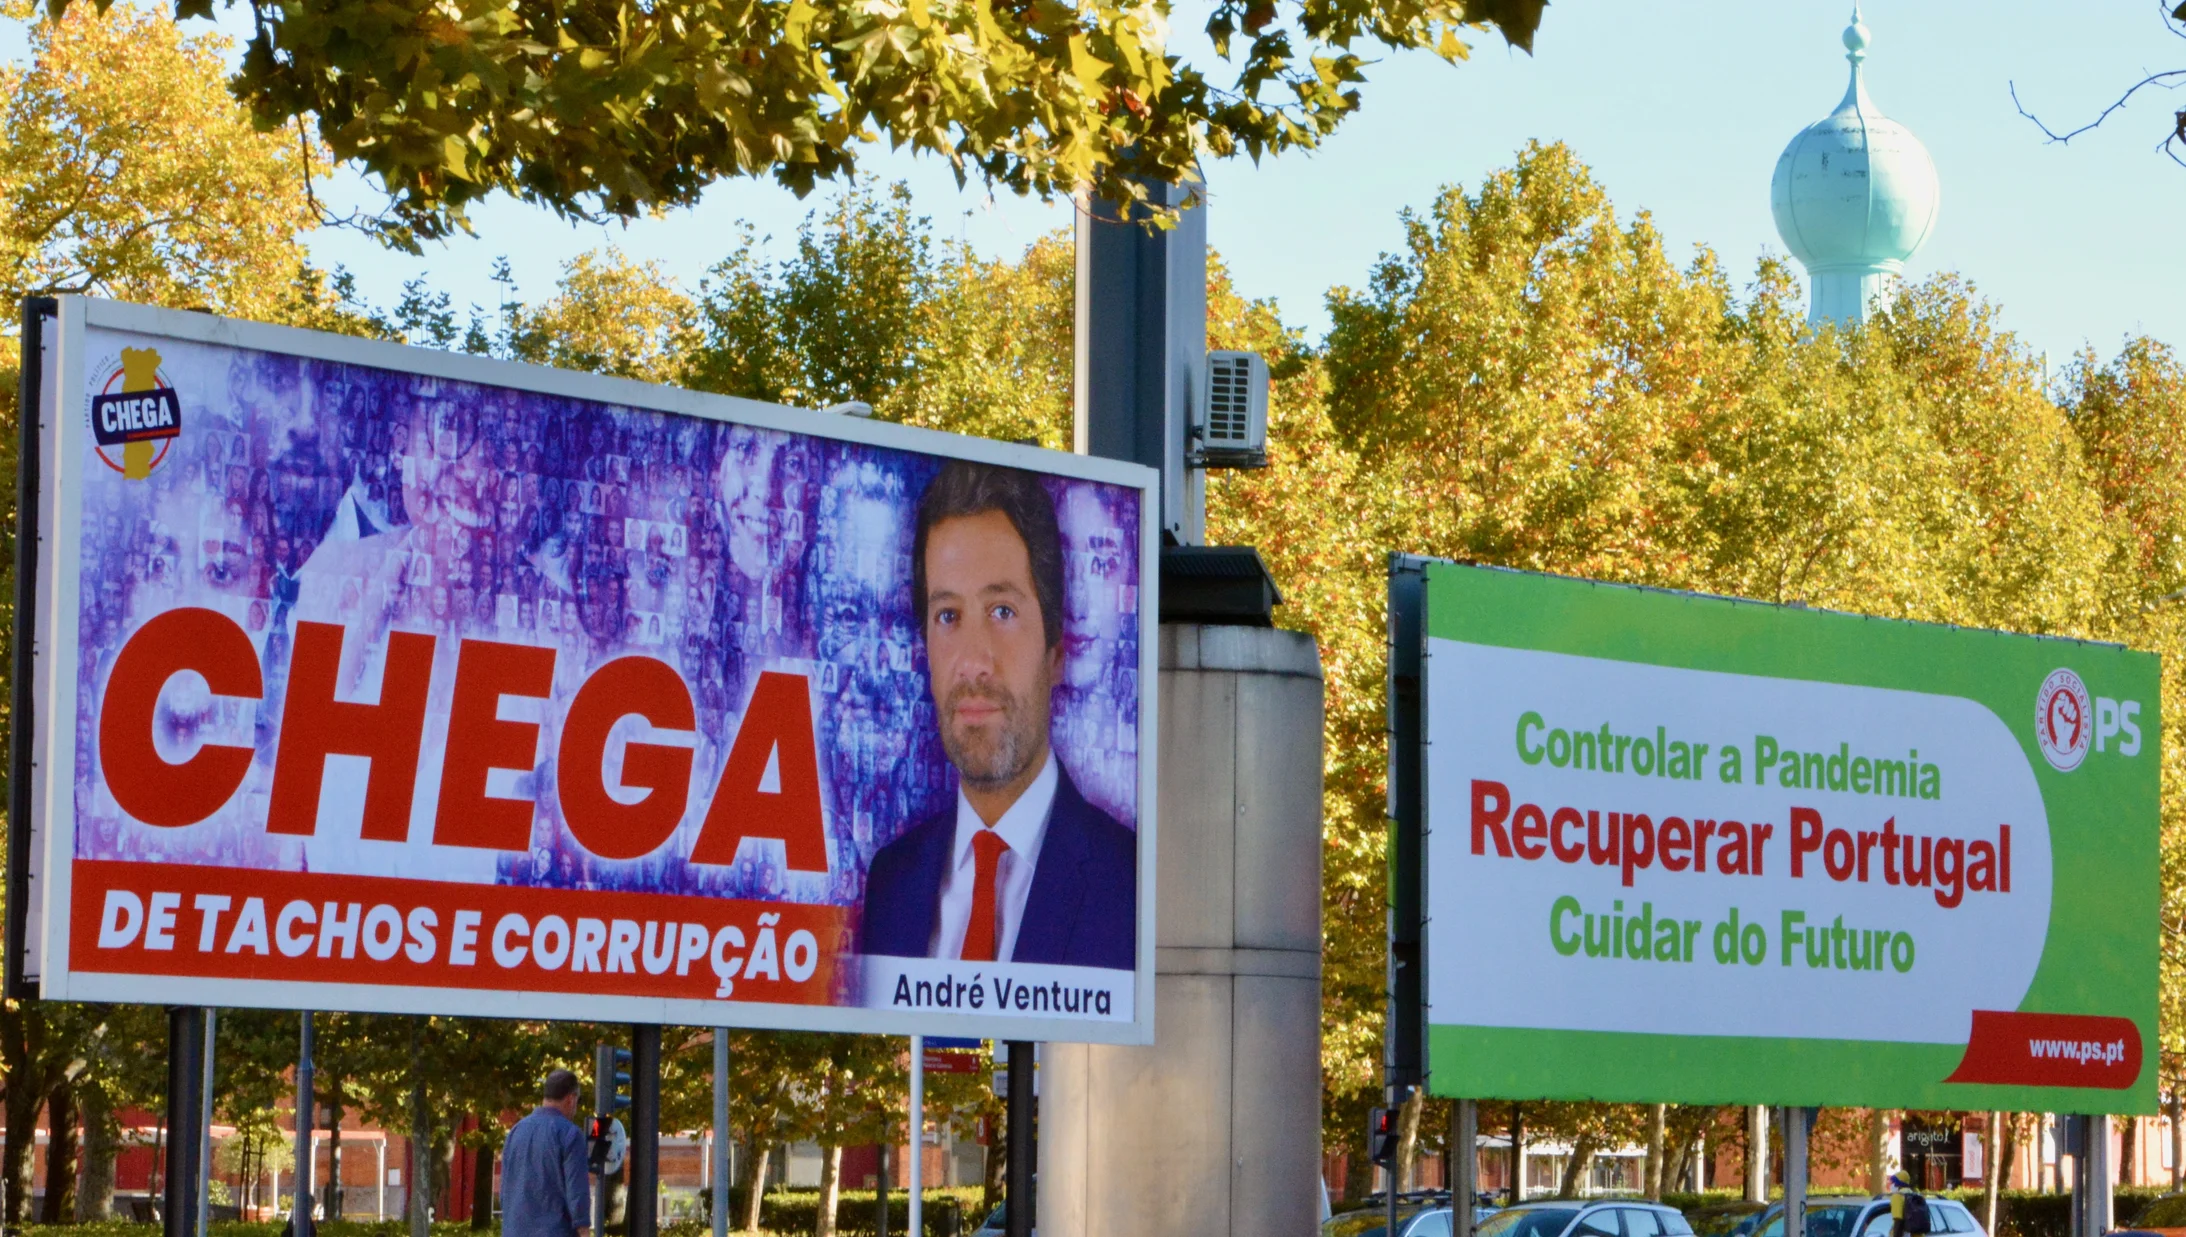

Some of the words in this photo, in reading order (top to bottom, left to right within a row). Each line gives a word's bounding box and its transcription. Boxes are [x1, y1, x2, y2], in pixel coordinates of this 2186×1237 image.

[101, 396, 174, 433] CHEGA
[99, 607, 828, 872] CHEGA
[2038, 680, 2055, 746] PARTIDO
[2059, 674, 2088, 750] SOCIALISTA
[2096, 696, 2142, 757] PS
[1516, 710, 1709, 780] Controlar
[1719, 745, 1742, 784] a
[1755, 734, 1941, 800] Pandemia
[1471, 779, 1773, 887] Recuperar
[1790, 806, 2010, 909] Portugal
[97, 889, 182, 951] DE
[194, 894, 439, 964] TACHOS
[448, 909, 483, 966] E
[491, 912, 819, 998] CORRUPÇÃO
[1549, 895, 1702, 963] Cuidar
[1713, 907, 1767, 966] do
[1781, 910, 1915, 973] Futuro
[893, 973, 984, 1009] André
[993, 978, 1111, 1015] Ventura
[2029, 1038, 2124, 1067] www.ps.pt
